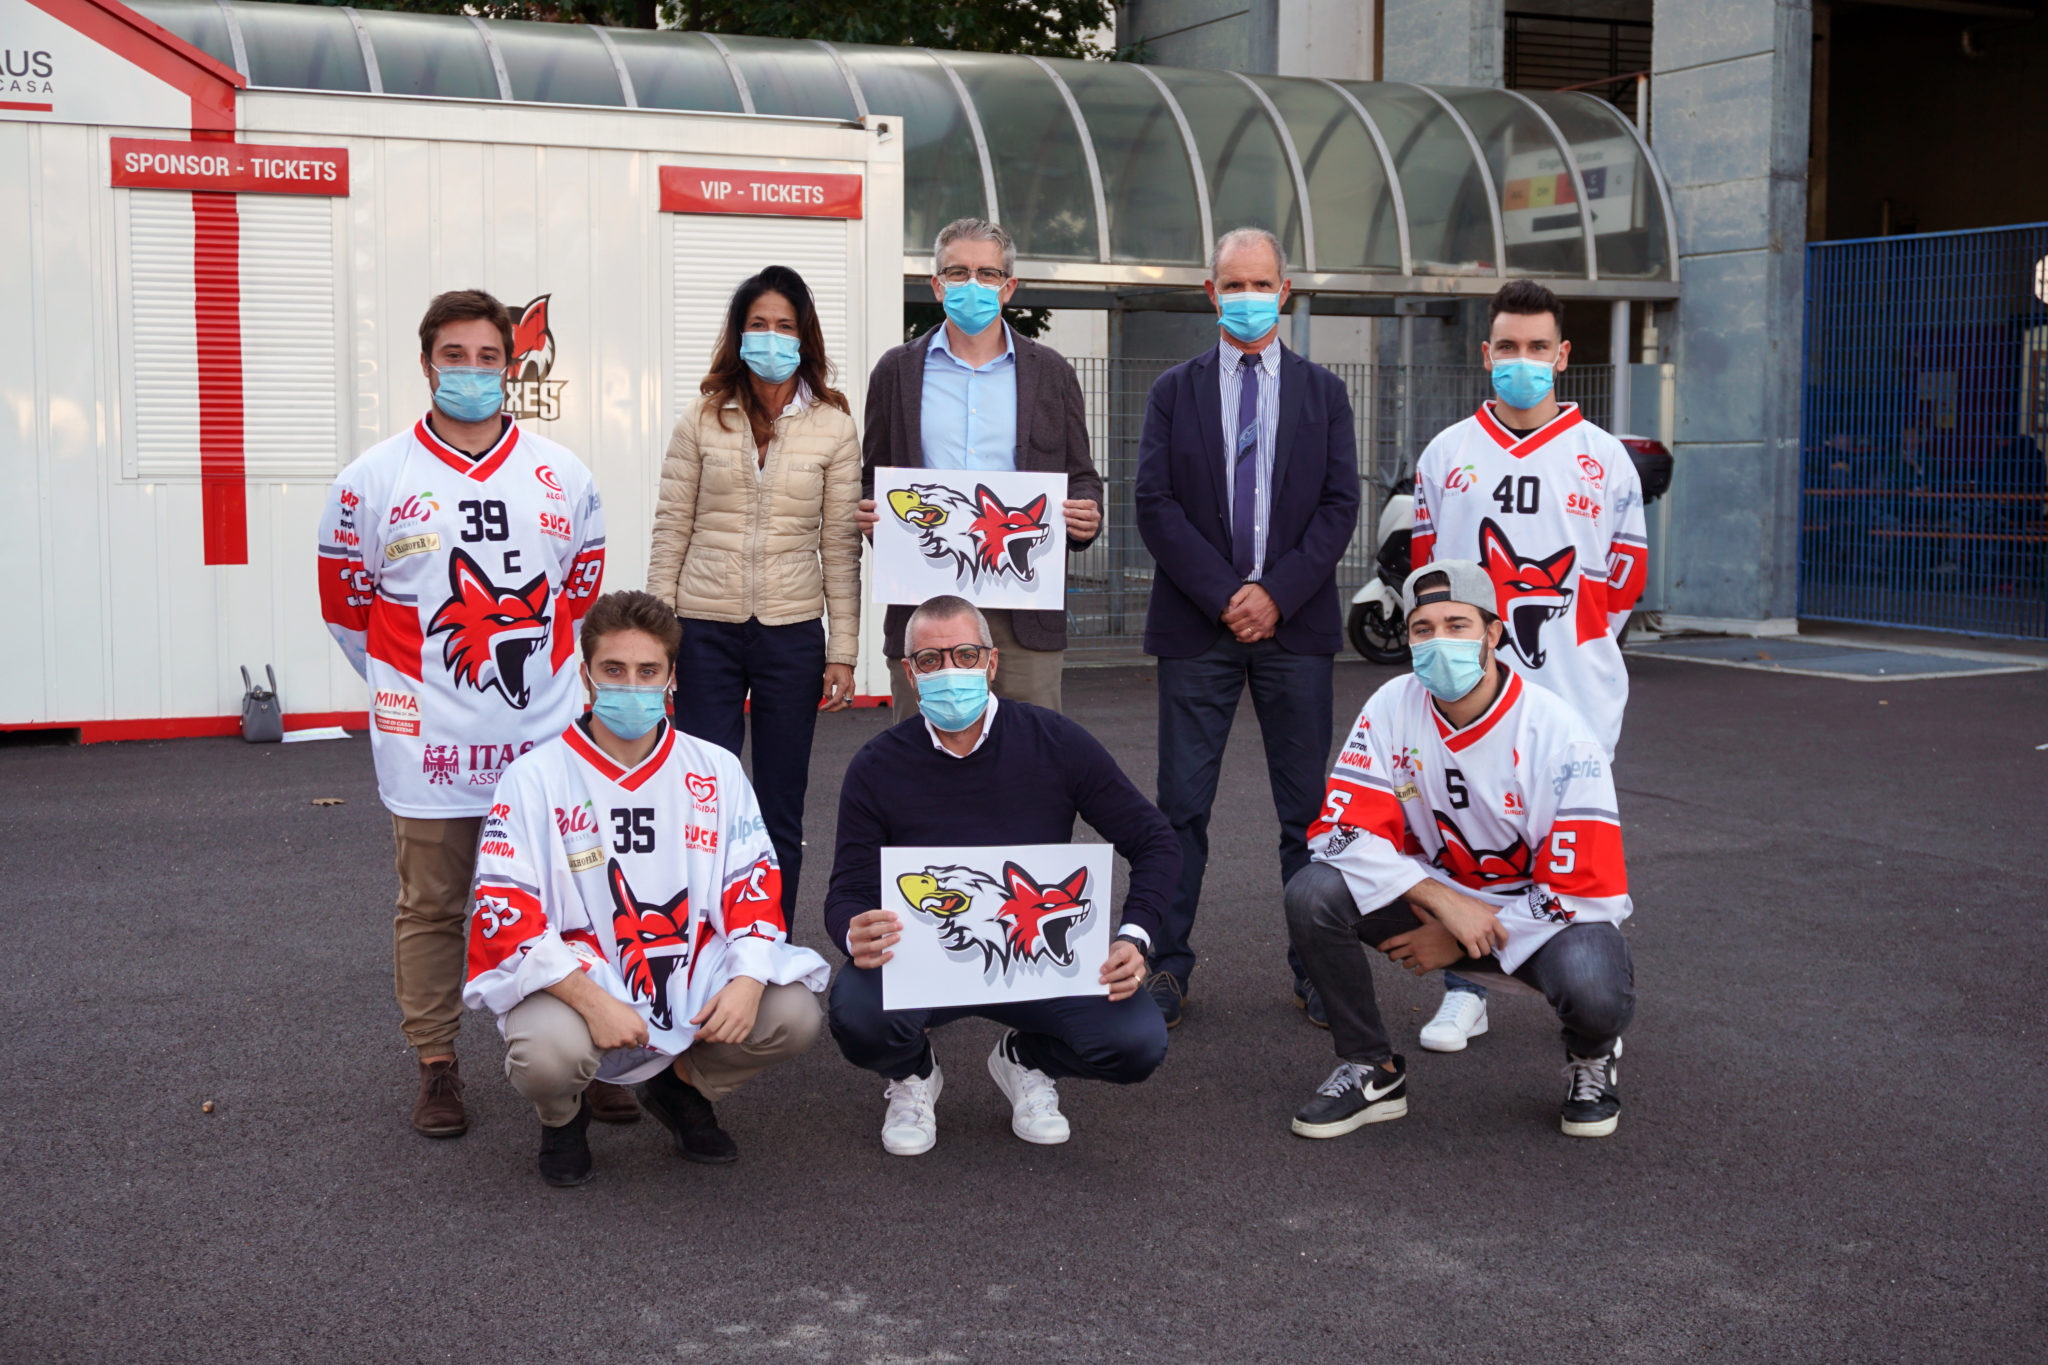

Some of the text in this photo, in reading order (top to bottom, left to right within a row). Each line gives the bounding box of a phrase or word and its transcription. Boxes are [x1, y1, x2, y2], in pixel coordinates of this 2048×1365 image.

[0, 49, 53, 78] US
[124, 152, 229, 177] SPONSOR
[250, 157, 337, 182] TICKETS
[700, 180, 732, 200] VIP
[750, 183, 824, 204] TICKETS
[502, 380, 568, 421] XES
[1493, 475, 1540, 514] 40
[458, 500, 509, 543] 39
[504, 550, 522, 574] C
[374, 691, 419, 713] MIMA
[1445, 768, 1469, 809] 5
[489, 803, 511, 821] AR
[1321, 789, 1353, 823] 5
[611, 808, 655, 854] 35
[1549, 831, 1577, 874] 5
